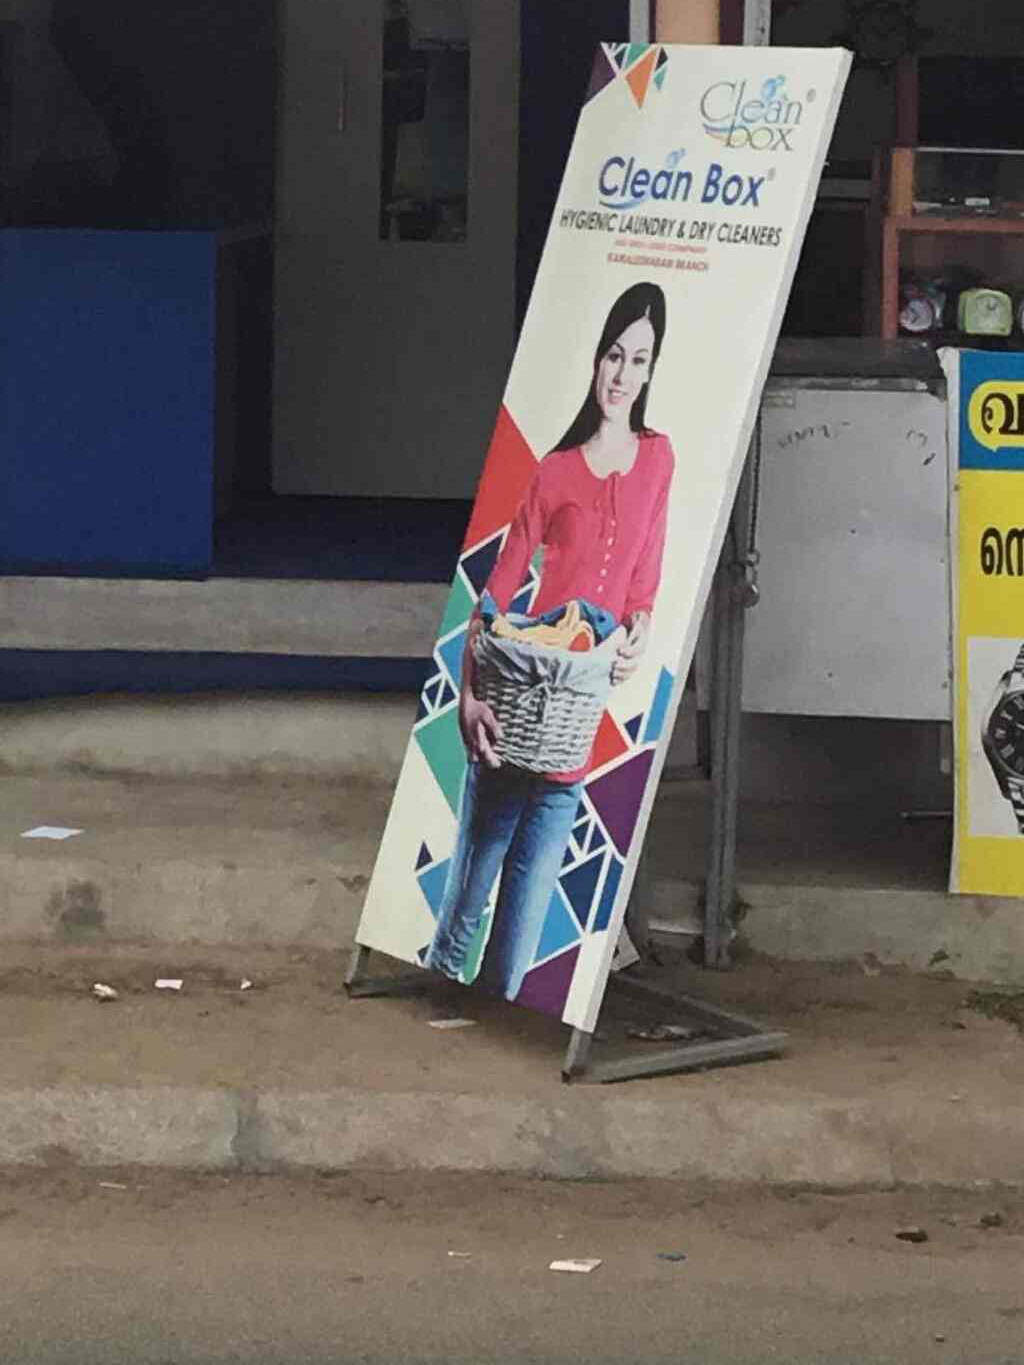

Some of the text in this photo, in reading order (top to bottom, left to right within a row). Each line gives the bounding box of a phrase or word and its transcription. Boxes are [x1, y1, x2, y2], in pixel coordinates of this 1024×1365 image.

[598, 155, 765, 207] Clean Box
[559, 209, 618, 233] HYGIENIC
[619, 214, 676, 238] LAUNDRY
[676, 219, 686, 238] &
[689, 220, 715, 242] DRY
[717, 222, 784, 247] CLEANERS
